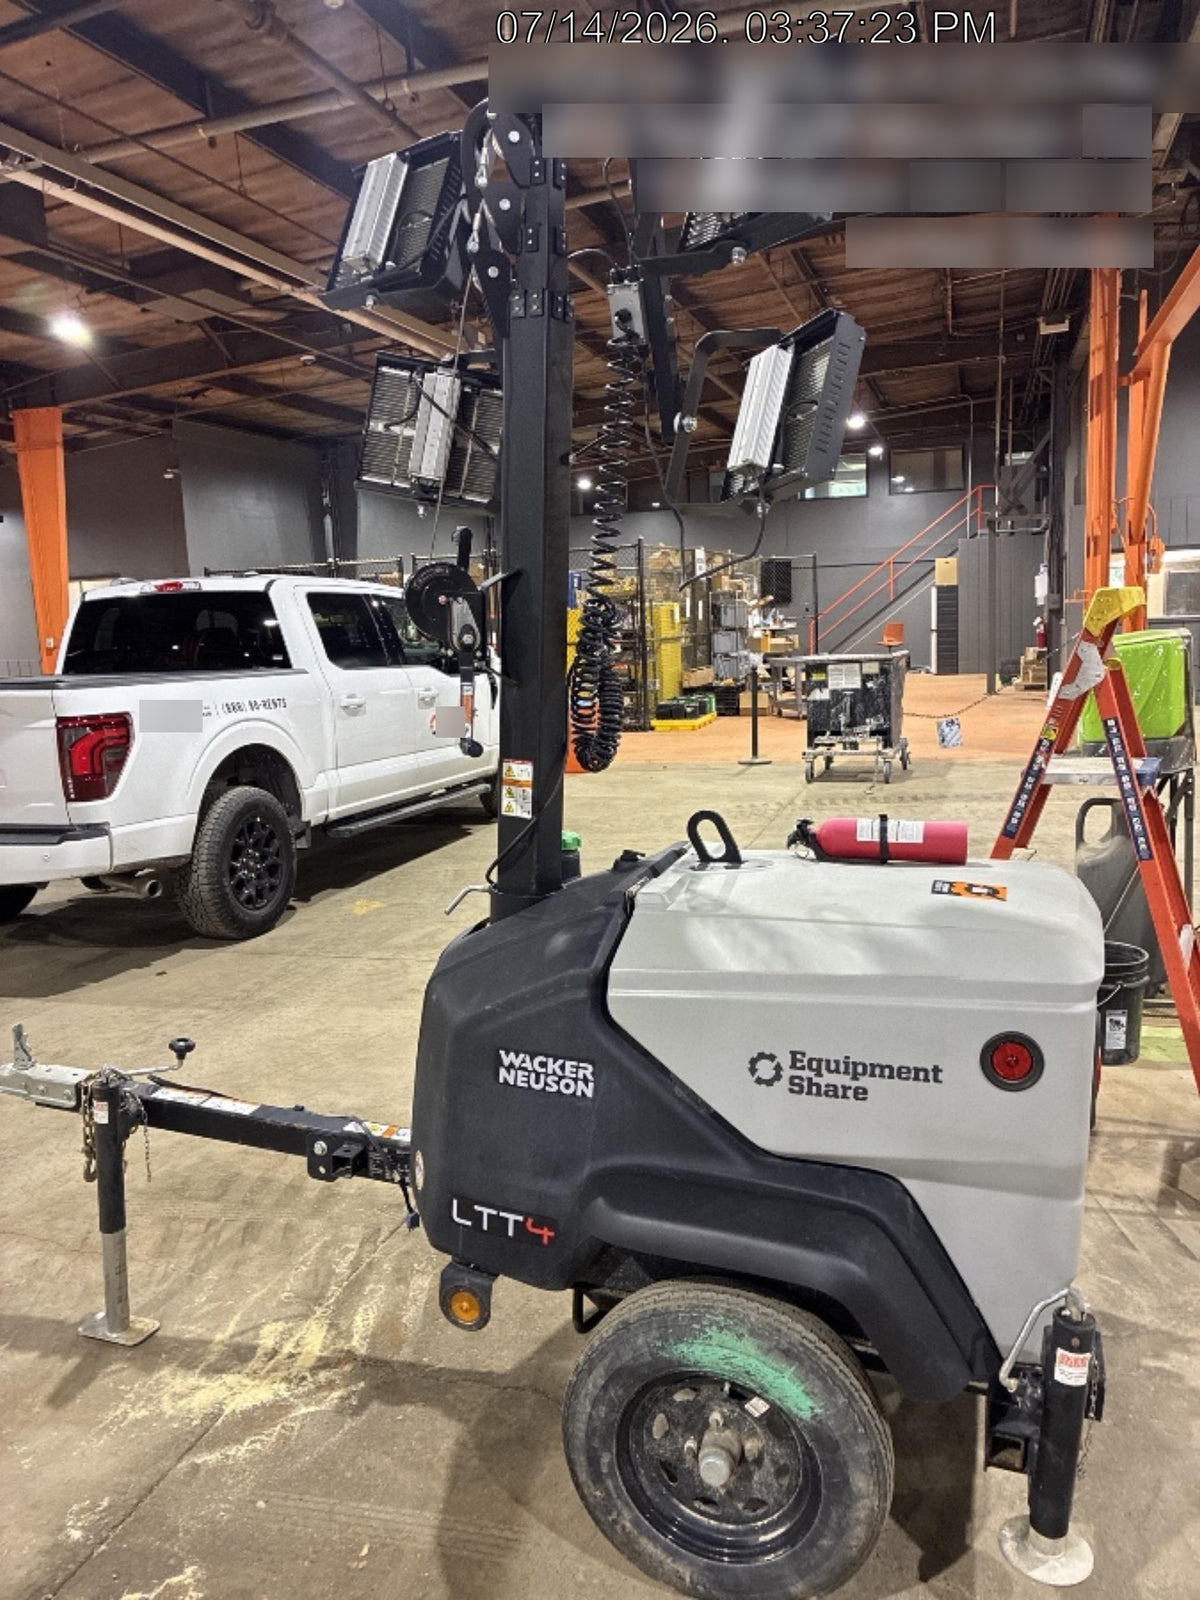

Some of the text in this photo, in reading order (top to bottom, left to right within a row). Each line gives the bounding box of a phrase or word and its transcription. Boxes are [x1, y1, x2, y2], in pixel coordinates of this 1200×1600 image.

[499, 1049, 594, 1081] WACKER
[789, 1050, 943, 1084] Equipment
[499, 1066, 594, 1098] NEUSON
[788, 1075, 868, 1101] Share
[452, 1198, 555, 1245] LTT4
